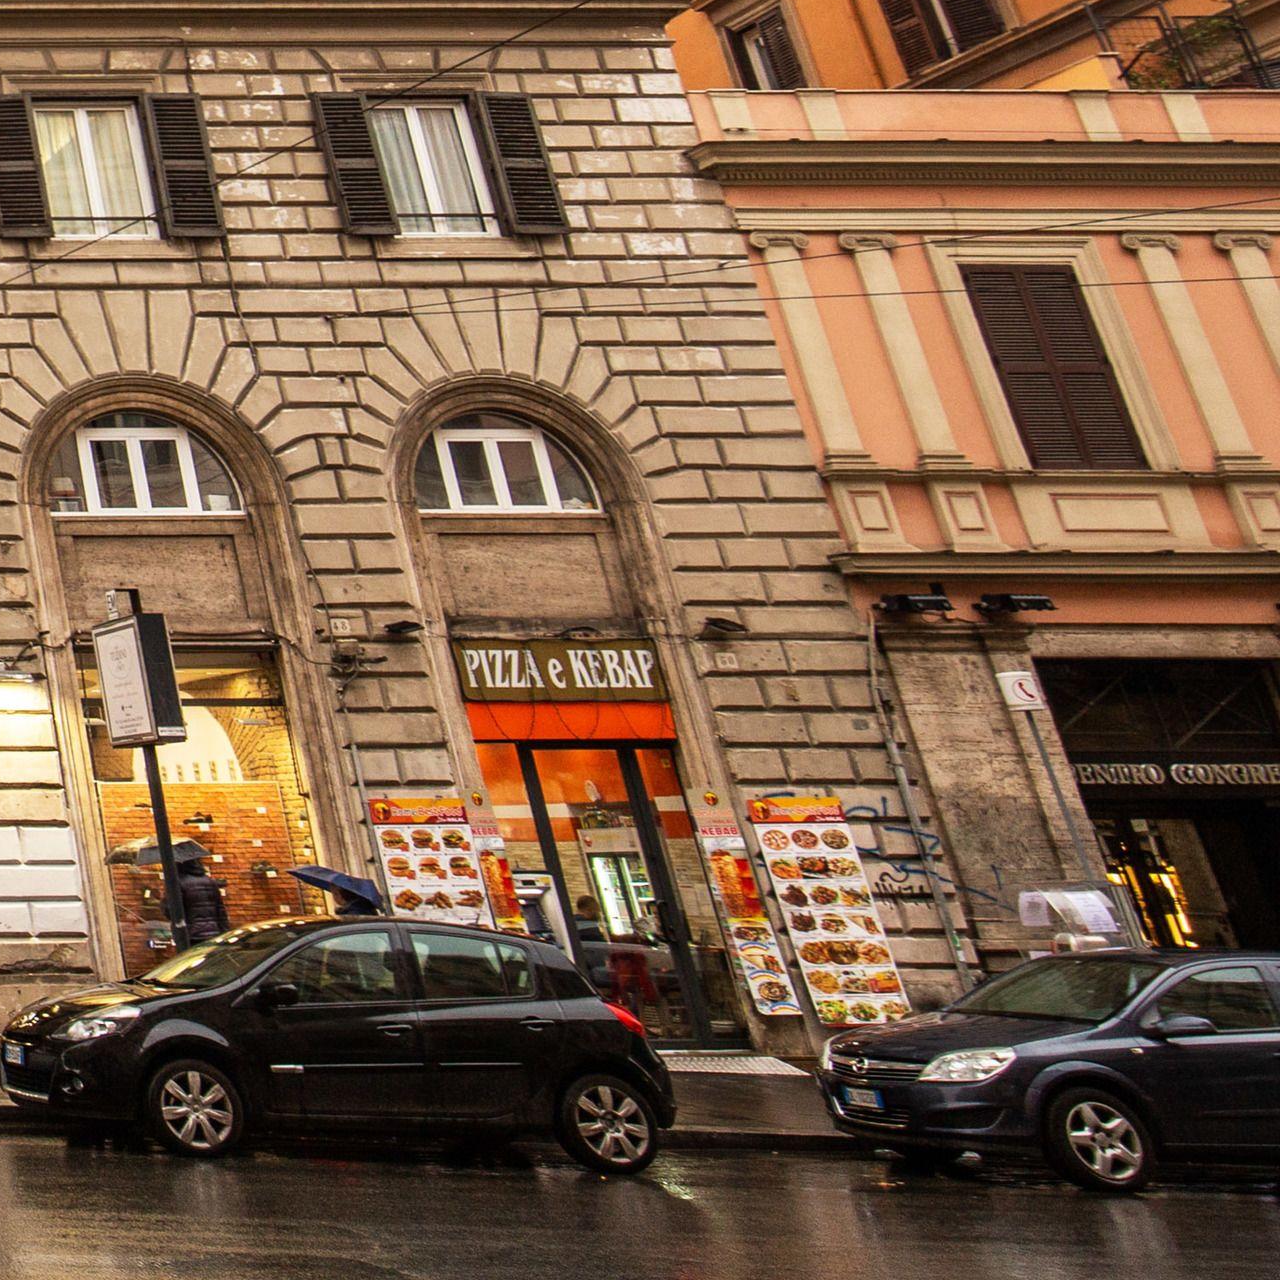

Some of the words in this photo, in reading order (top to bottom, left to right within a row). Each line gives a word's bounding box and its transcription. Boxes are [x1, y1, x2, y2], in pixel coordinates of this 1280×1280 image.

[462, 649, 545, 689] PIZZA
[548, 659, 567, 689] e
[701, 827, 738, 835] KEBAB
